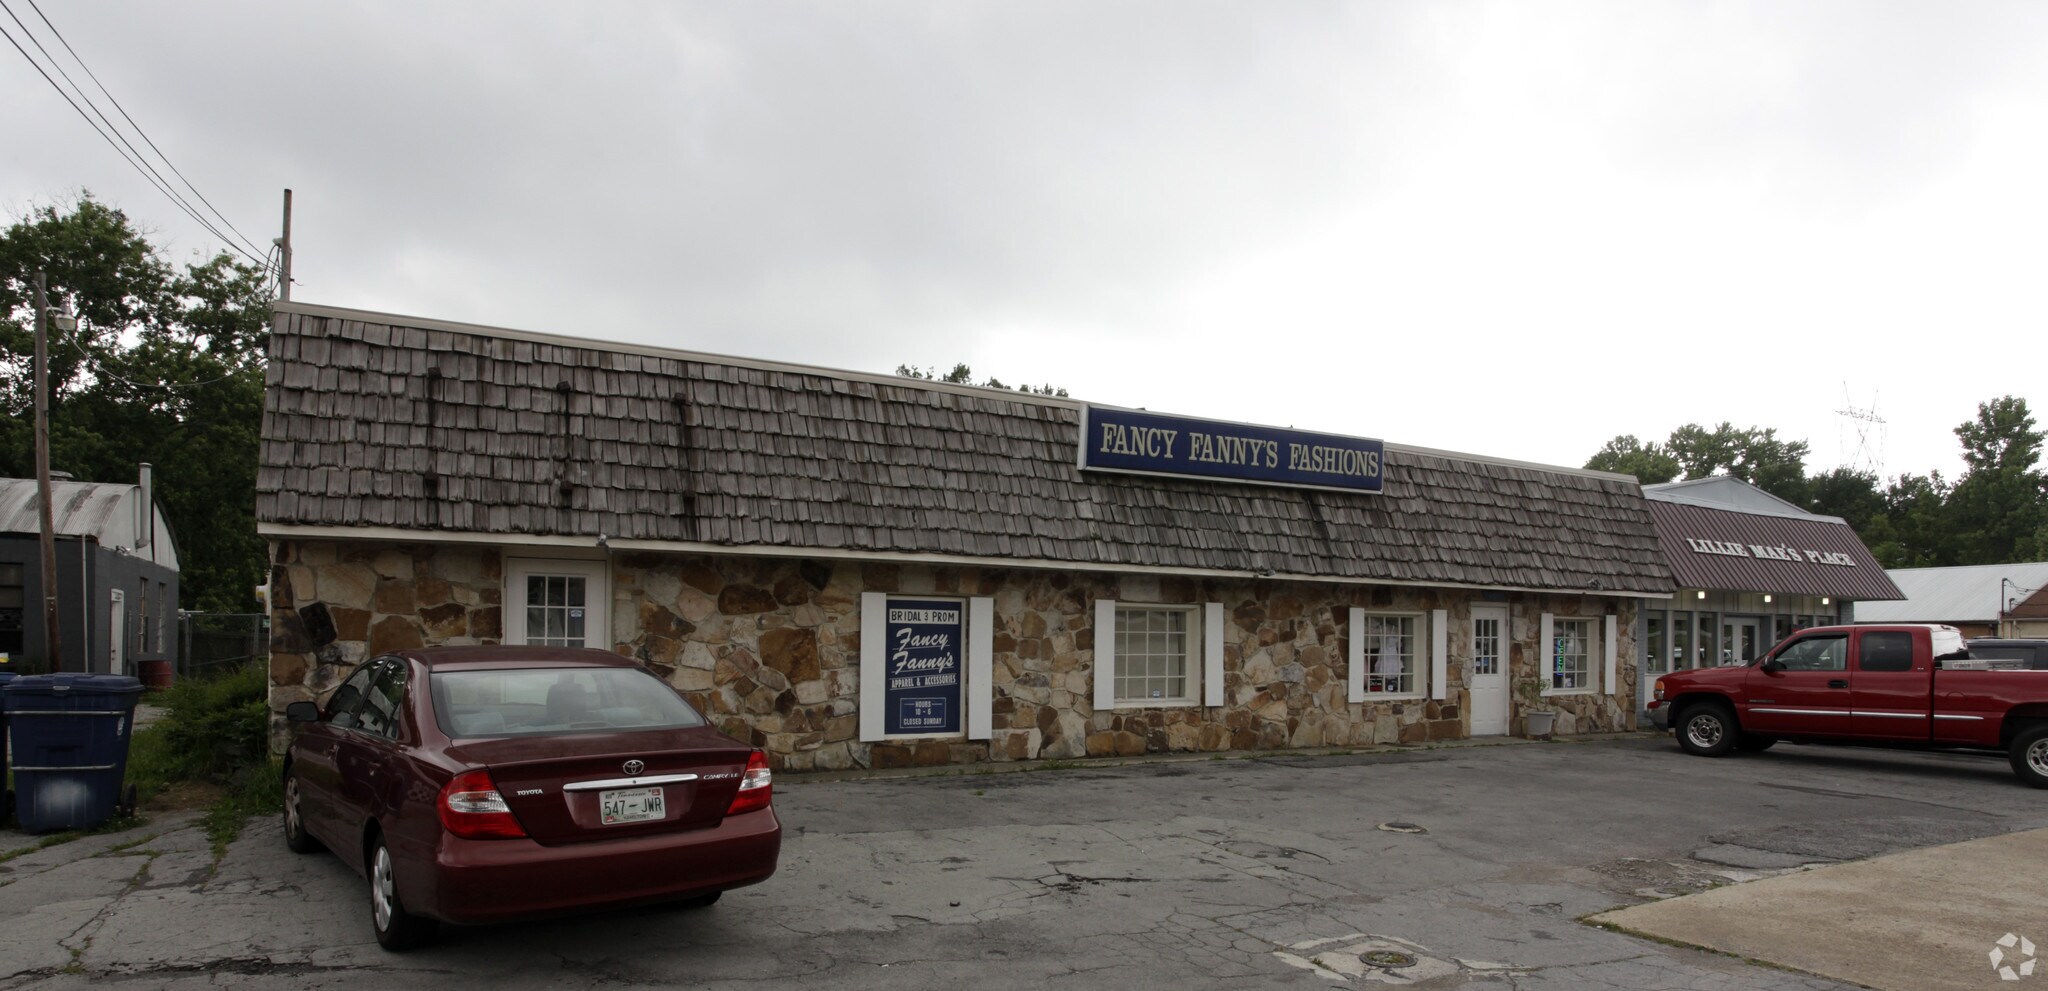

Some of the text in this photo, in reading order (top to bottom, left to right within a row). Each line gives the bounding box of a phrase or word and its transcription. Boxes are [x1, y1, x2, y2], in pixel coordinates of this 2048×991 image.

[1100, 423, 1379, 478] FANCY FANNY'S FASHIONS
[1686, 538, 1856, 567] LILLIE MAE'S PLACE
[891, 611, 921, 621] BRIDAL
[932, 611, 955, 622] PROM
[896, 627, 948, 651] Fancy
[892, 651, 954, 675] Fanny's
[891, 674, 956, 688] APPAREL & ACCESSORIES
[923, 717, 942, 725] SUNDAY
[516, 788, 543, 796] TOYOTA
[604, 800, 625, 816] 547
[641, 797, 662, 813] JWR
